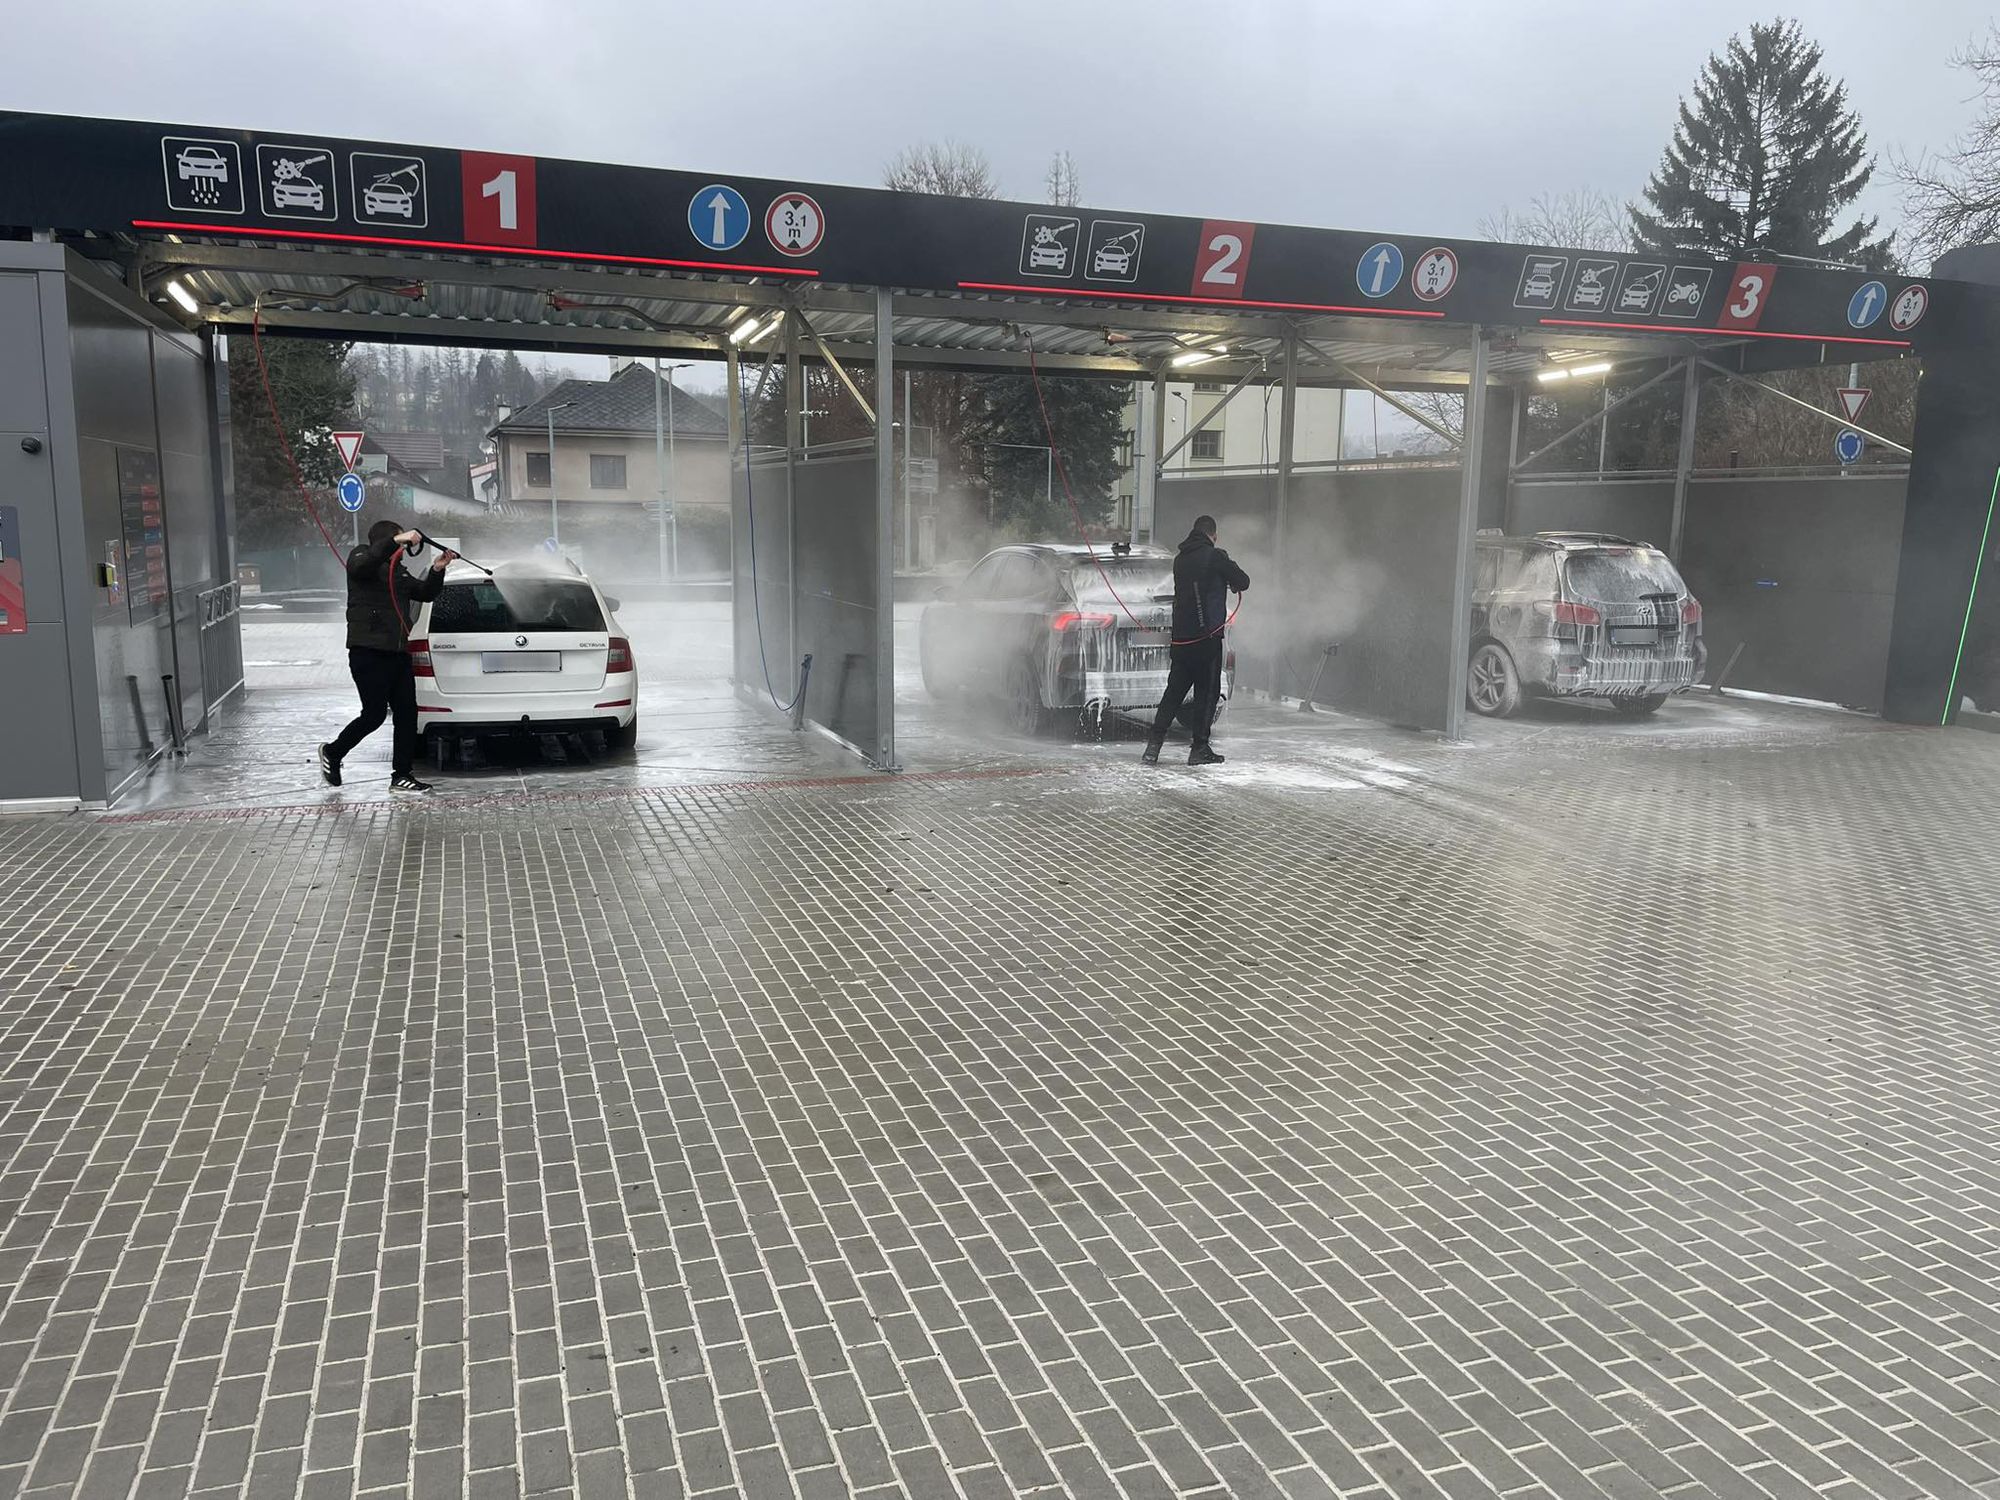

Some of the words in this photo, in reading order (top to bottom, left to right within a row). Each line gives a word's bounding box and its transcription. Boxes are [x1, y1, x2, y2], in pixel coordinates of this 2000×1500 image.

[483, 170, 517, 230] 1
[785, 211, 806, 227] 3.1
[788, 228, 800, 238] m
[1202, 234, 1242, 285] 2
[1427, 263, 1445, 276] 3.1
[1428, 277, 1439, 285] m
[1731, 275, 1763, 318] 3
